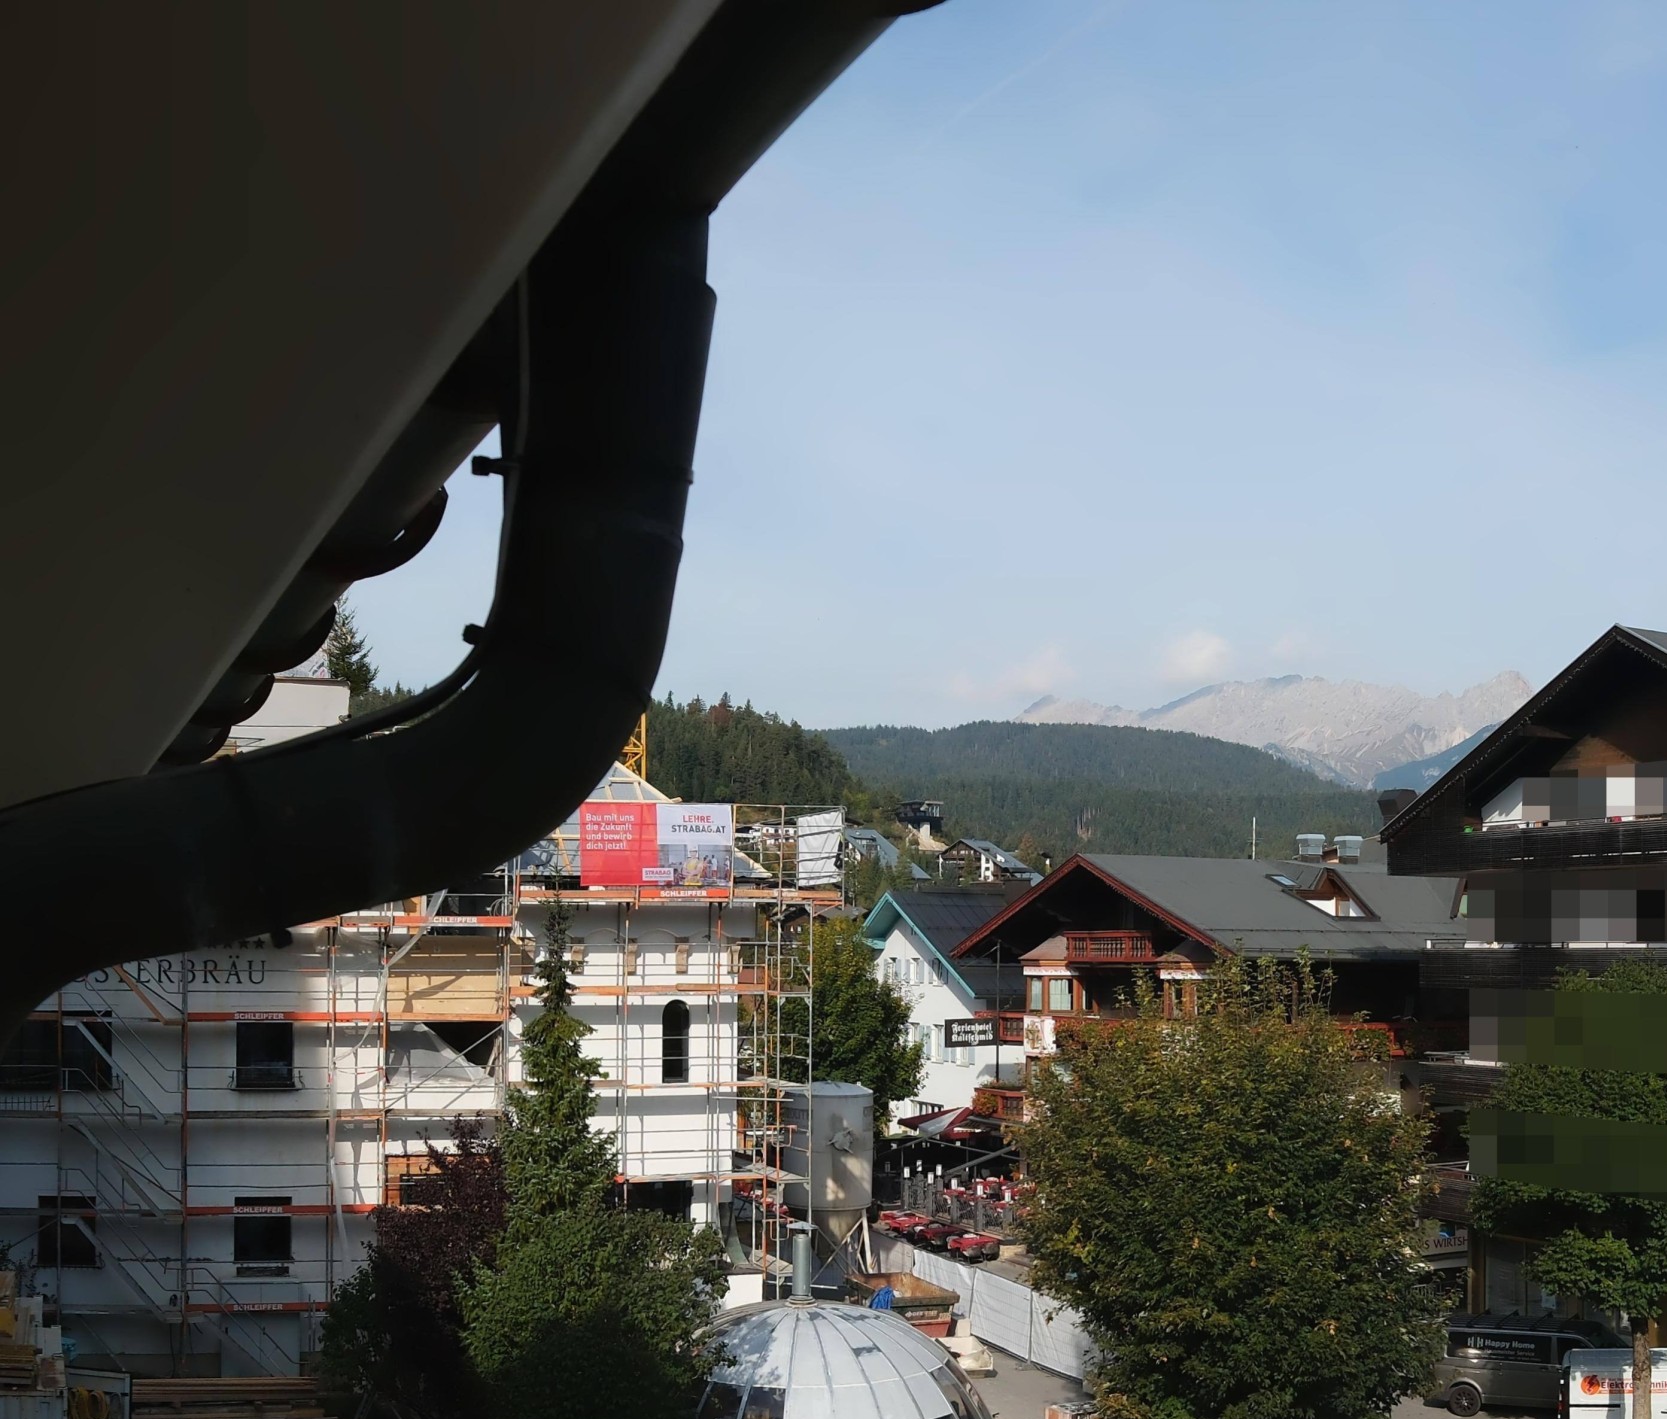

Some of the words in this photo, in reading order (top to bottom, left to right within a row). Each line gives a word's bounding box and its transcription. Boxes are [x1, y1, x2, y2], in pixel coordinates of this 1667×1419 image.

[684, 815, 714, 823] LEHRE.
[586, 823, 598, 831] die
[601, 823, 632, 831] Zukunft
[672, 824, 726, 833] STRABAG.AT
[586, 832, 601, 840] und
[604, 832, 632, 840] bewirb
[586, 841, 603, 850] dich
[605, 841, 626, 851] jetzt!
[1485, 1339, 1510, 1348] Happy
[1512, 1340, 1535, 1349] Home
